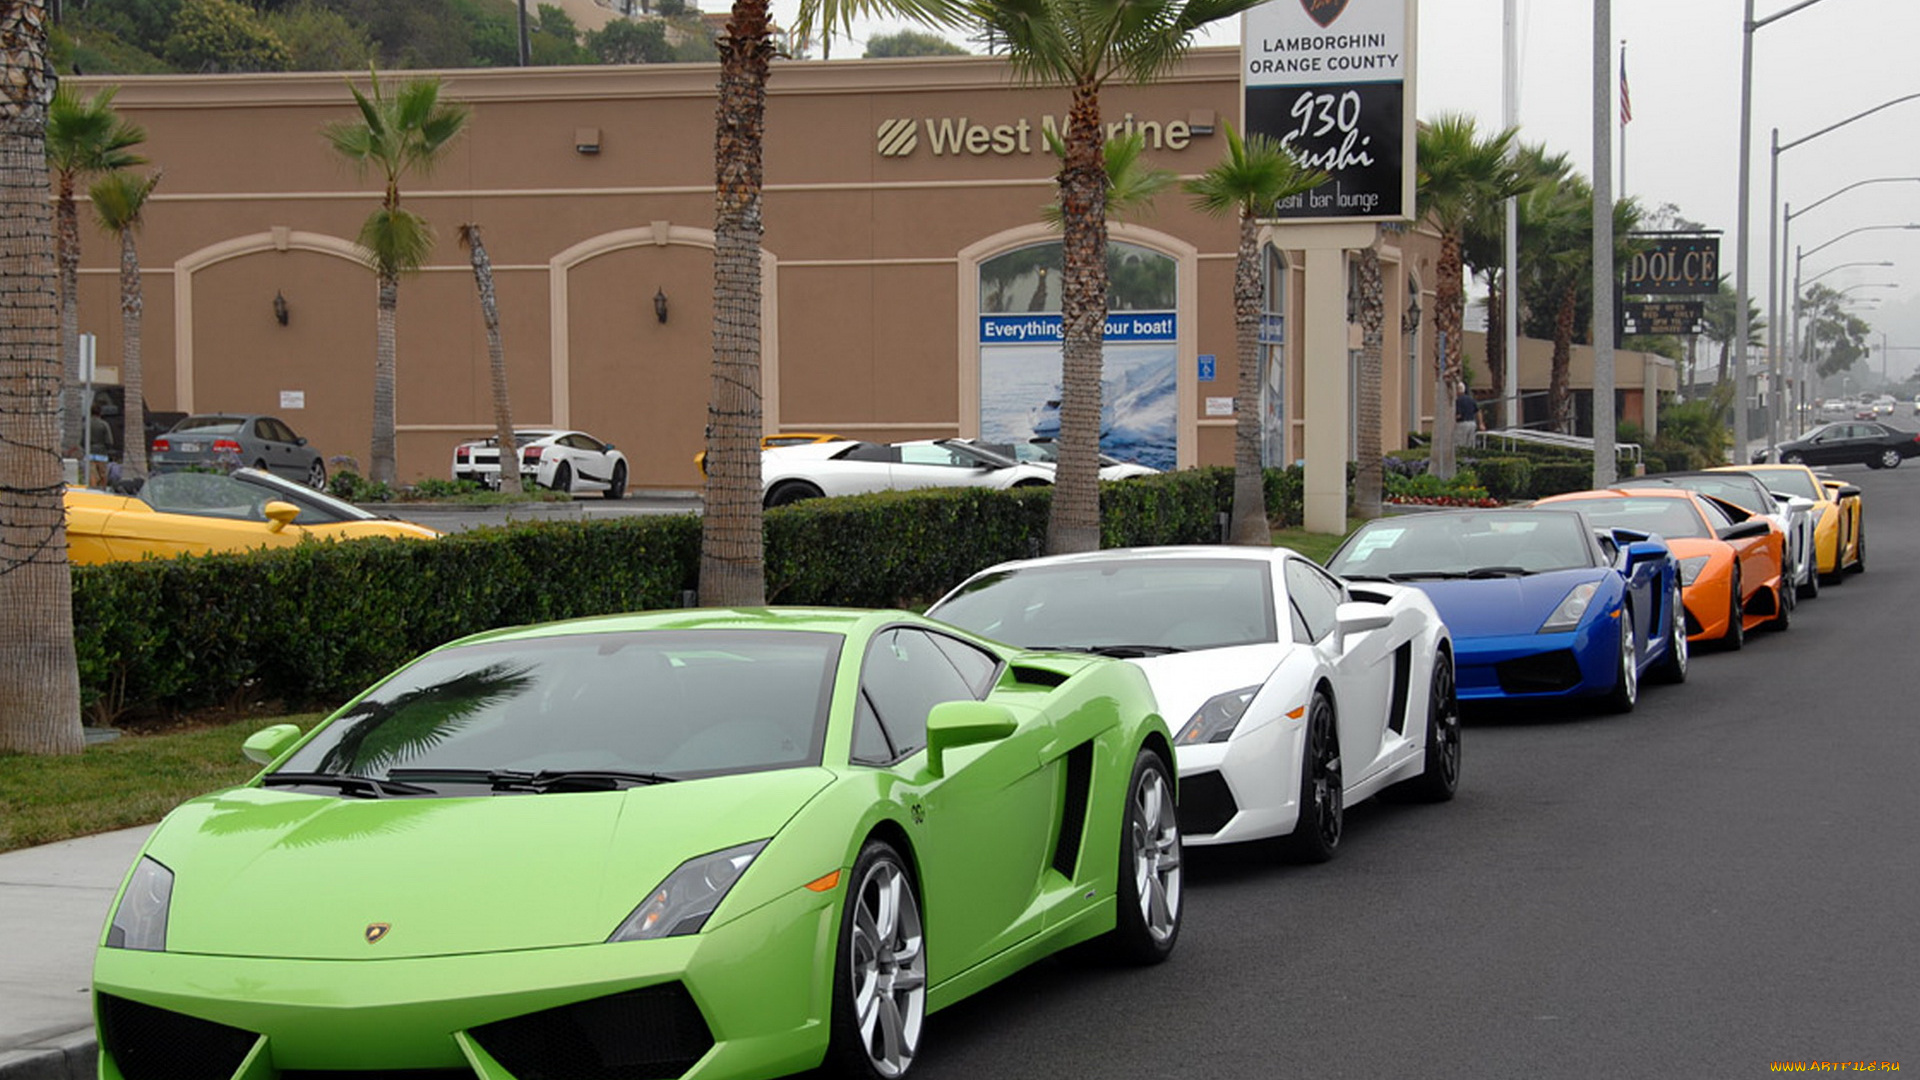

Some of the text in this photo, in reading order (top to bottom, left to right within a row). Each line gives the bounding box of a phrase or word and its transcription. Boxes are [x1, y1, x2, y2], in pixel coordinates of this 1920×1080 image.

[1263, 34, 1386, 53] LAMBORGHINI
[1250, 54, 1399, 74] ORANGE COUNTY
[1291, 90, 1361, 137] 930
[925, 112, 1190, 154] West Mrine
[1310, 189, 1333, 208] bar
[1336, 180, 1379, 213] lounge
[1103, 321, 1129, 335] our
[1133, 320, 1172, 335] boat!
